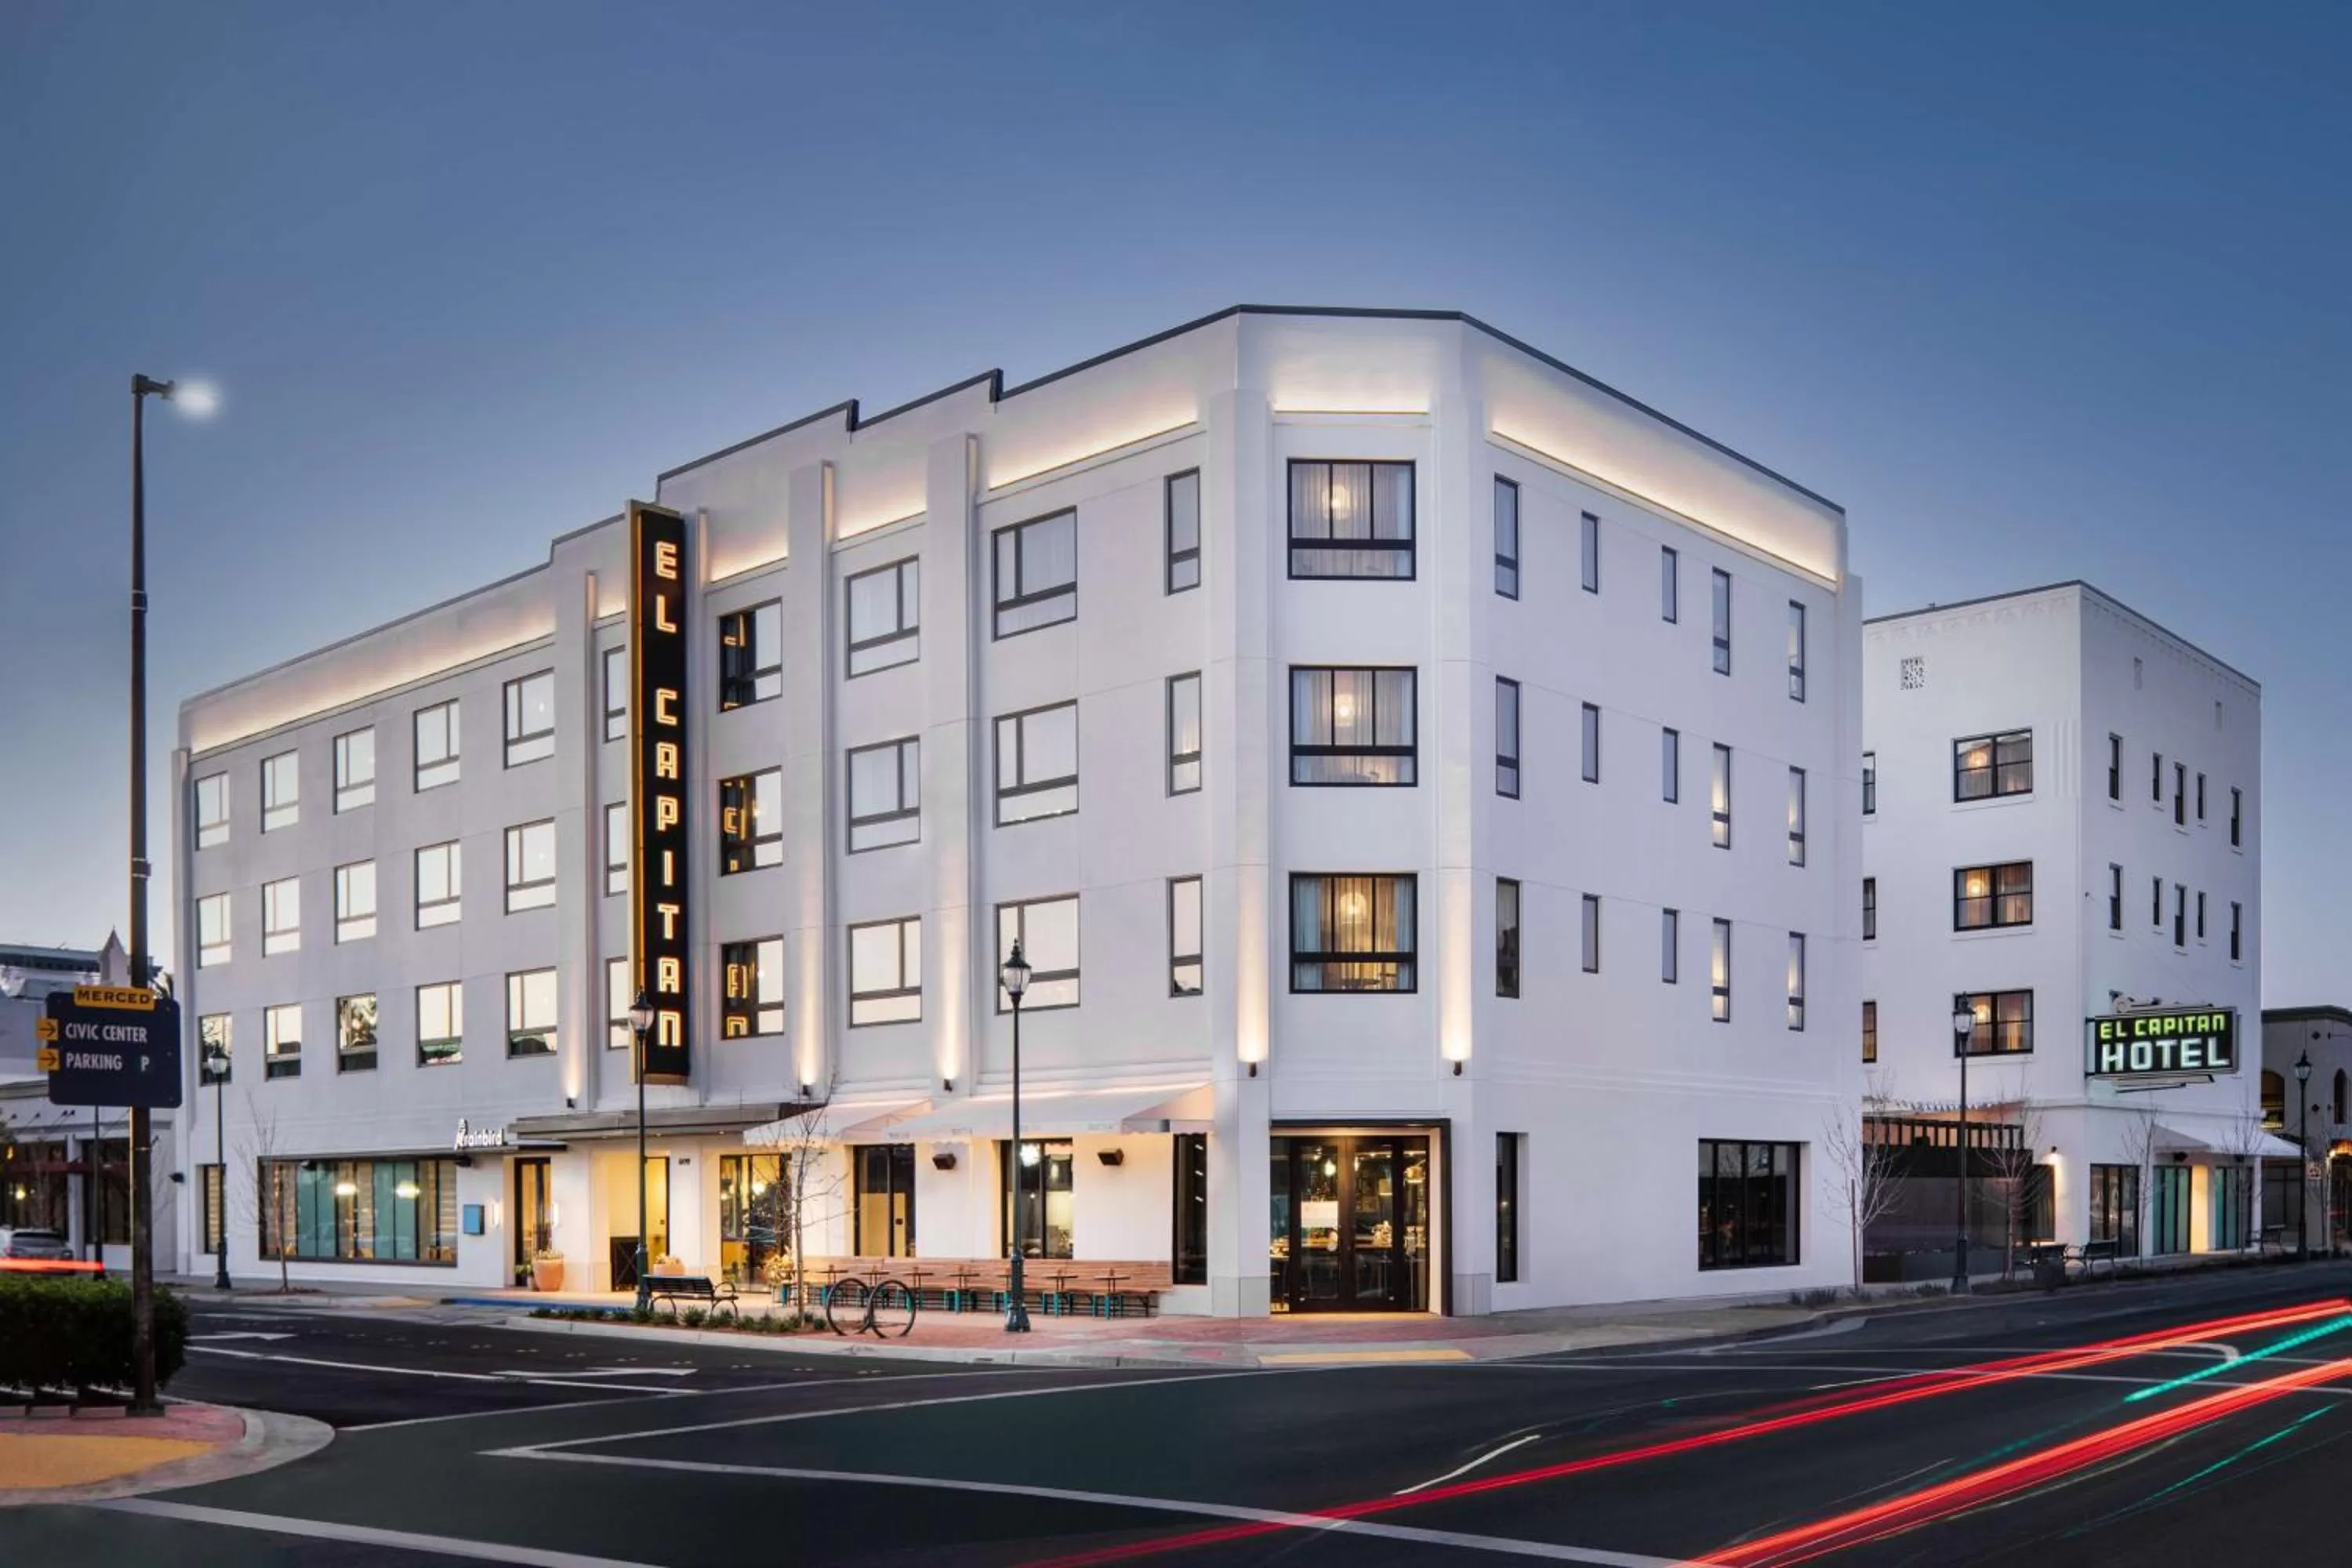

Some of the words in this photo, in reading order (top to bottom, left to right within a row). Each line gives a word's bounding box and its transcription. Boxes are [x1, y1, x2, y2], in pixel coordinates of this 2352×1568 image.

[655, 540, 678, 633] EL
[655, 688, 681, 1047] CAPITAN
[78, 989, 150, 1004] MERCED
[65, 1022, 99, 1040] CIVIC
[103, 1025, 147, 1043] CENTER
[2100, 1021, 2127, 1039] EL
[2134, 1014, 2225, 1036] CAPITAN
[67, 1053, 122, 1070] PARKING
[2101, 1037, 2229, 1072] HOTEL
